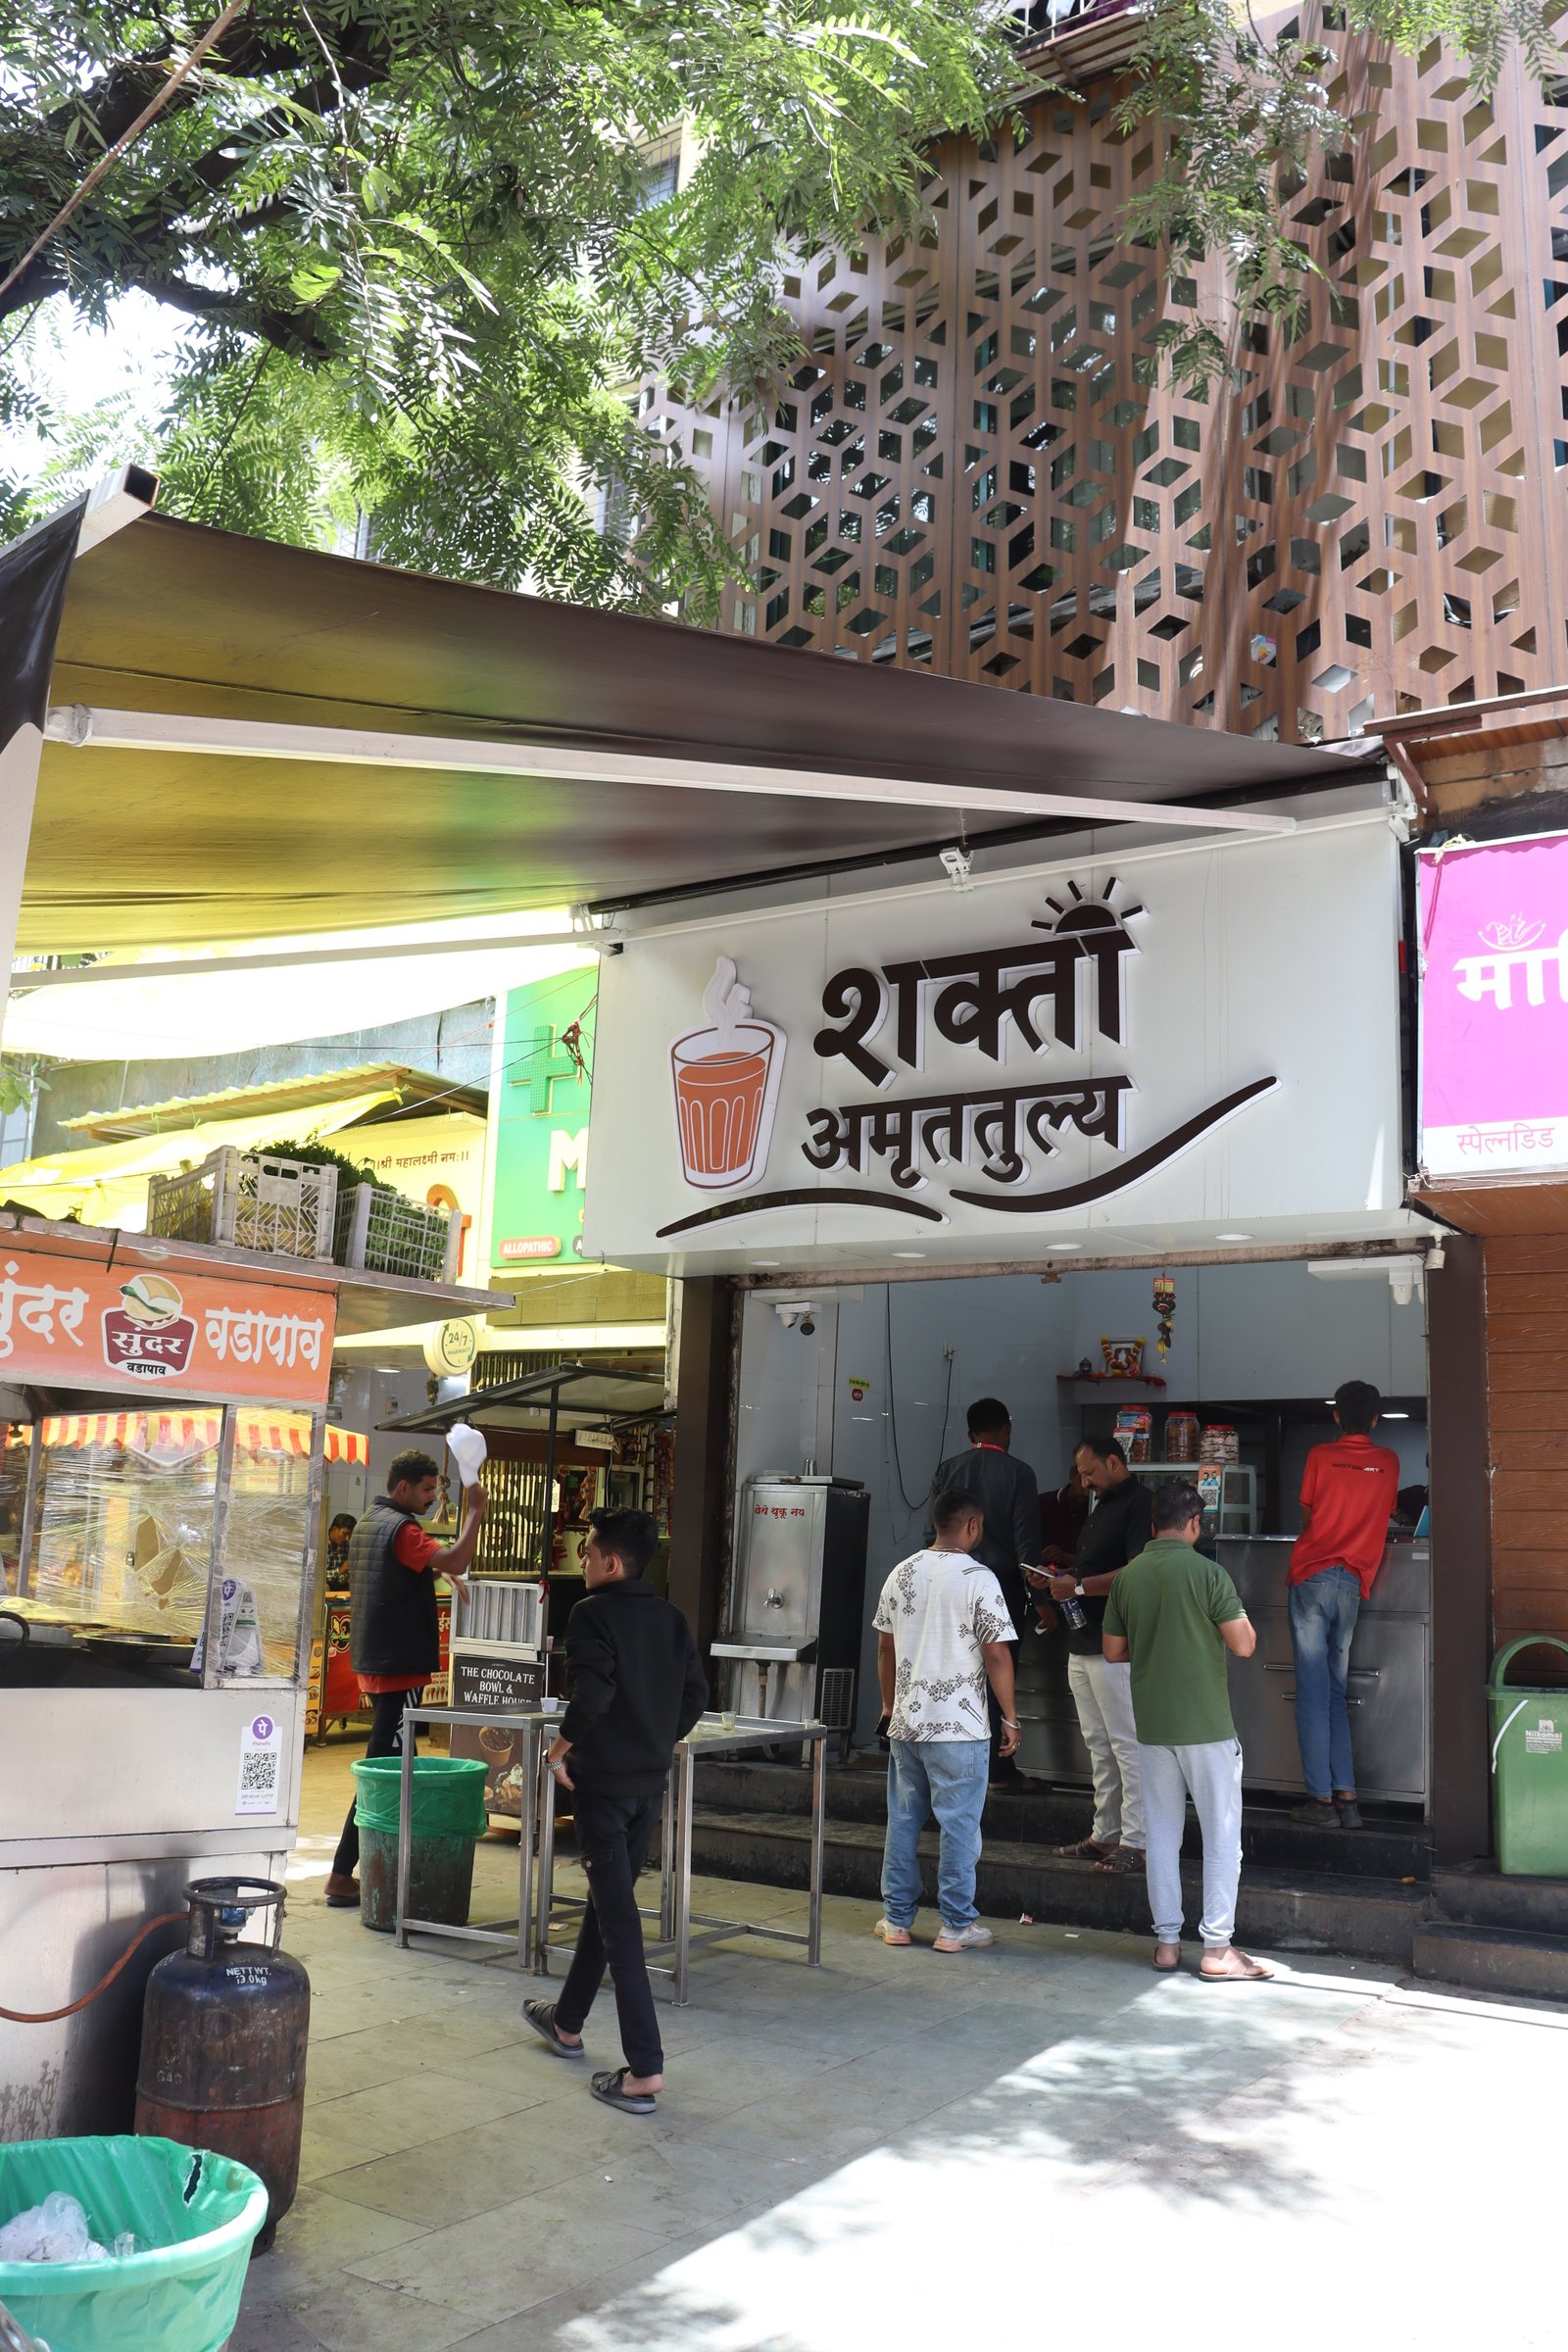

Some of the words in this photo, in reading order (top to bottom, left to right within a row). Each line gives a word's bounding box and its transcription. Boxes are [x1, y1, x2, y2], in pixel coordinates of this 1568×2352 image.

[801, 1075, 1140, 1191] अमृततुल्य
[396, 1151, 438, 1168] महालक्ष्मी
[503, 1240, 553, 1254] ALLOPATHIC
[111, 1326, 185, 1357] सुंदर
[205, 1306, 324, 1371] वडापाव
[448, 1331, 468, 1348] 24/7
[126, 1361, 166, 1376] वडापाव
[461, 1666, 479, 1678] THE
[480, 1668, 535, 1685] CHOCOLATE
[479, 1681, 504, 1693] BOWL
[506, 1684, 514, 1694] &
[464, 1690, 500, 1705] WAFFLE
[225, 1966, 253, 1977] NETT
[254, 1966, 272, 1976] WT.
